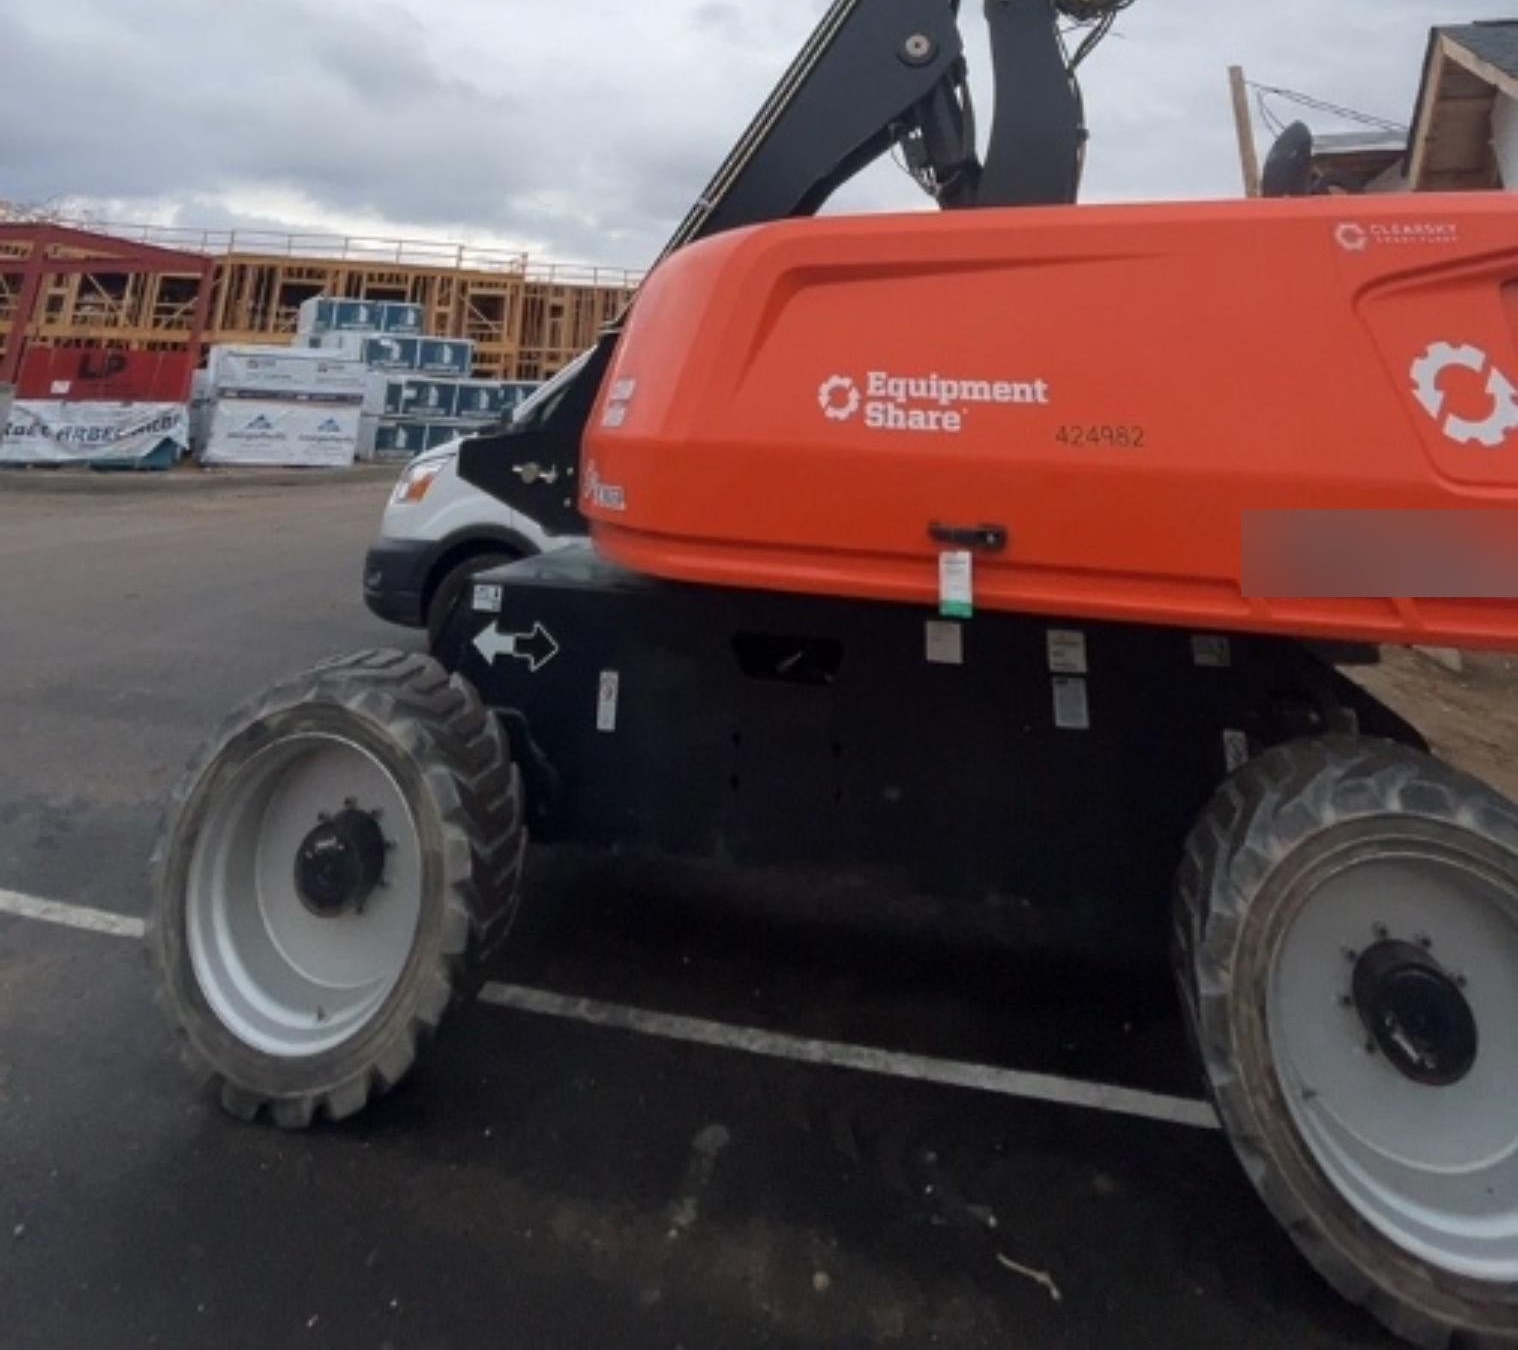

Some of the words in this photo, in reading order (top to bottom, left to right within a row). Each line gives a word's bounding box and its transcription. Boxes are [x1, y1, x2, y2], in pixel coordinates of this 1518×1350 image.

[865, 370, 1049, 404] Equipment
[864, 401, 962, 432] Share
[1055, 425, 1145, 448] 424982
